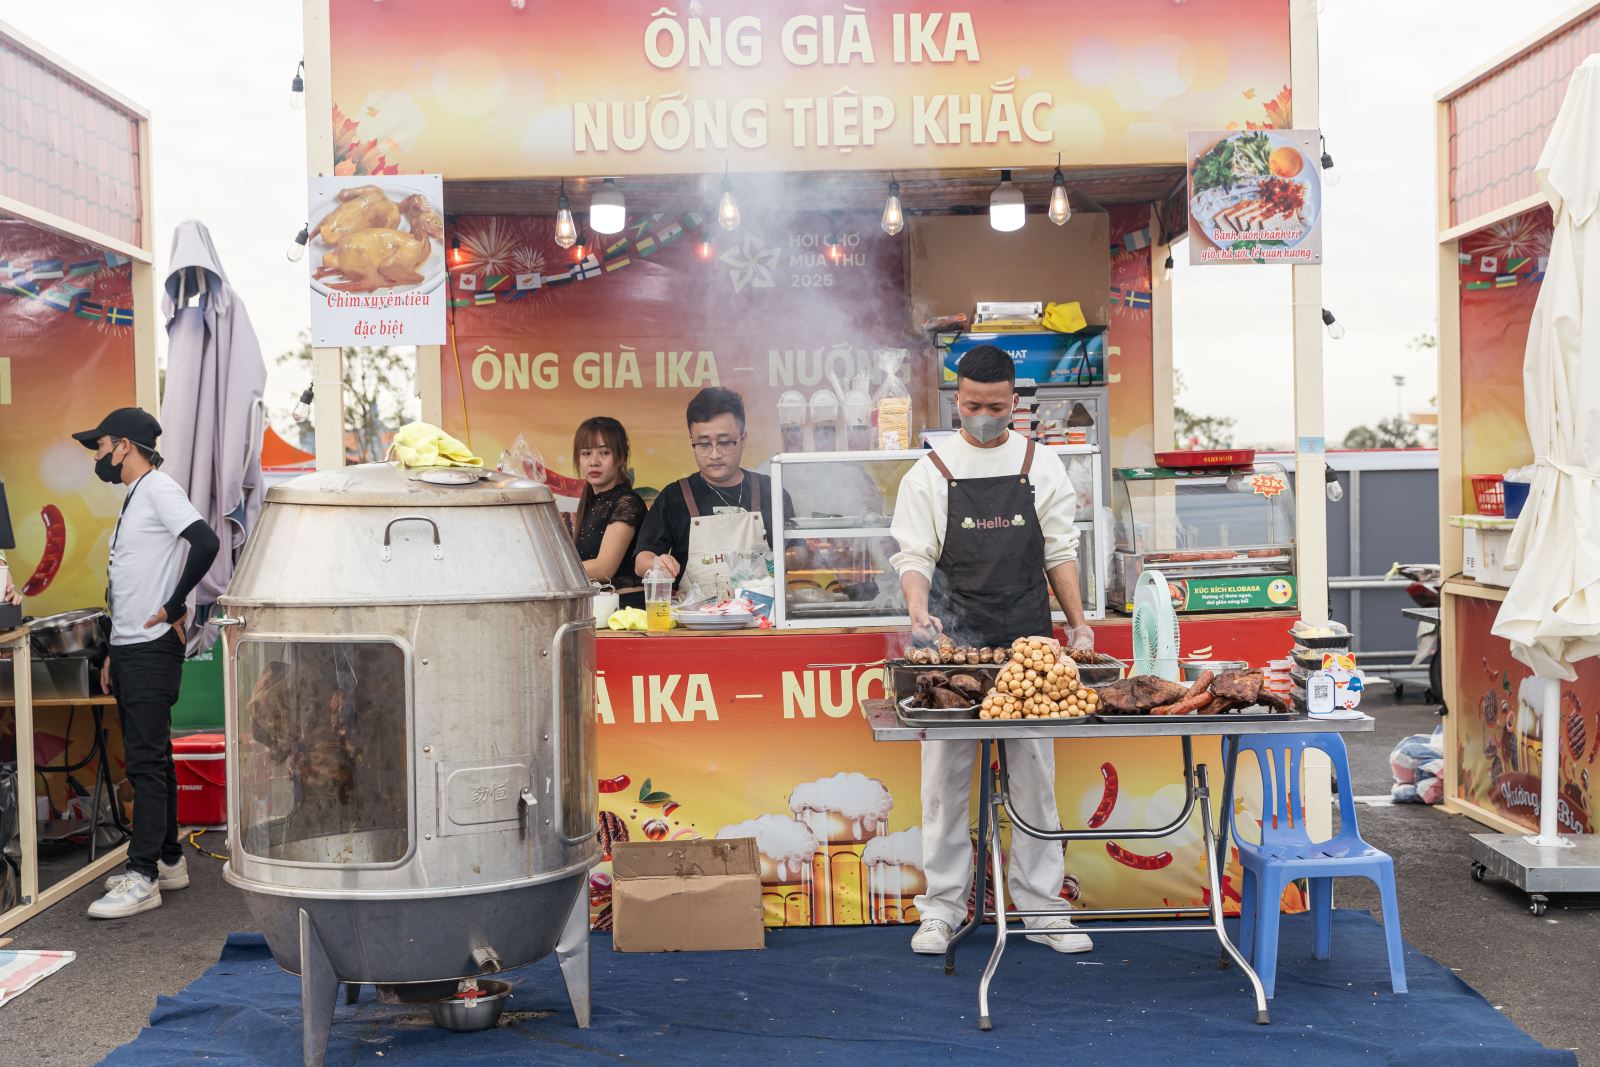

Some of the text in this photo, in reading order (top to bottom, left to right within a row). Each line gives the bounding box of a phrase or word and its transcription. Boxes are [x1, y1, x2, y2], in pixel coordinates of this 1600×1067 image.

[644, 4, 981, 68] ÔNG GIÀ IKA
[573, 76, 1053, 153] NƯỚNG TIỆP KHẮC
[790, 231, 819, 251] HỘI
[1260, 229, 1287, 240] thanh
[790, 251, 866, 267] MÙA THU
[790, 274, 833, 288] 2025
[327, 291, 430, 310] Chim xuyên tiêu
[354, 320, 405, 340] đặc biệt
[471, 345, 559, 390] ÔNG
[573, 344, 643, 389] GIÀ
[655, 351, 721, 388] IKA
[1256, 477, 1281, 488] 25K
[976, 516, 1010, 530] Hello
[1194, 585, 1261, 594] XÚC XÍCH KLOBASA
[631, 673, 720, 724] IKA
